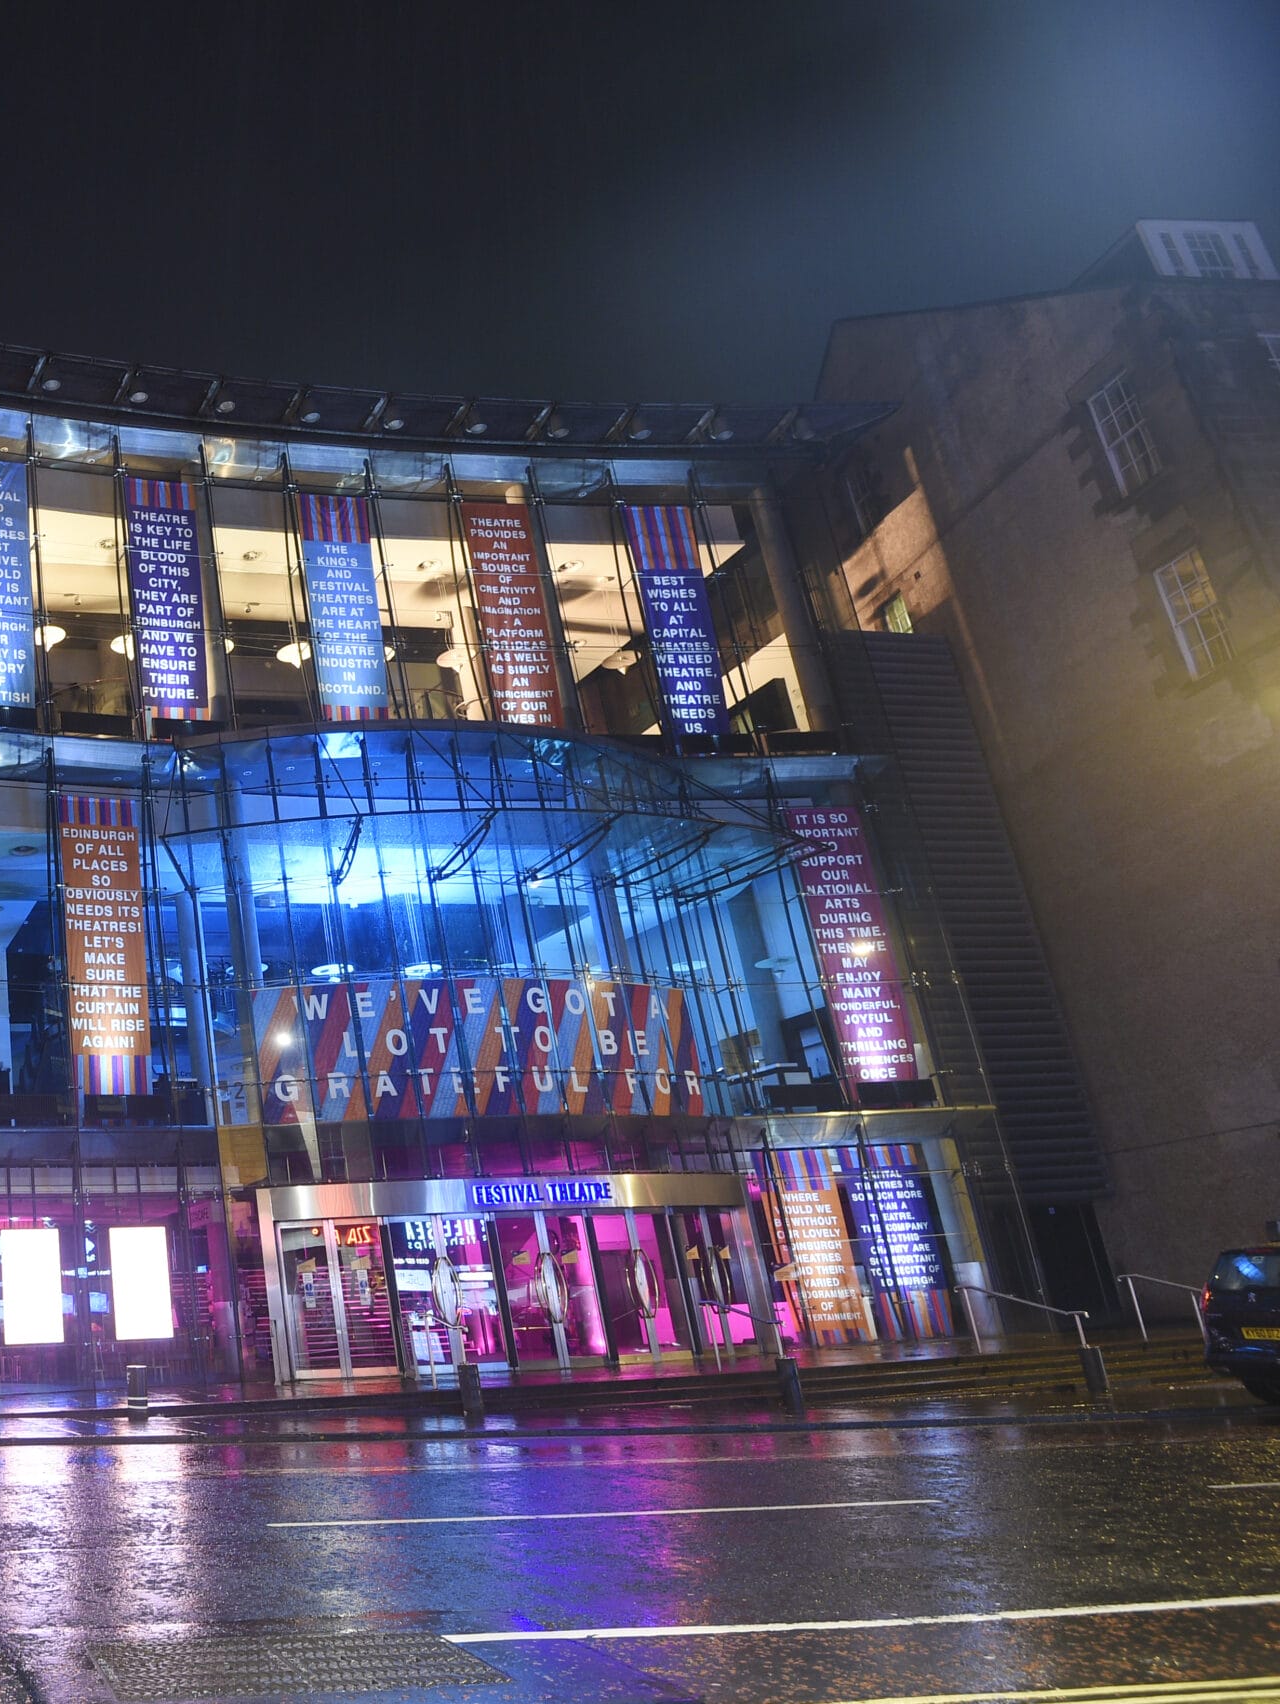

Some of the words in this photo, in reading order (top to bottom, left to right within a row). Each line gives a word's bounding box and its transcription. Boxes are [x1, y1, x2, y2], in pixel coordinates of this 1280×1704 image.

[133, 511, 188, 524] THEATRE
[471, 517, 521, 527] THEATRE
[470, 529, 526, 539] PROVIDES
[141, 550, 186, 563] BLOOD
[317, 557, 358, 566] KING'S
[474, 553, 530, 561] IMPORTANT
[481, 563, 526, 573] SOURCE
[327, 570, 352, 579] AND
[149, 578, 181, 591] CITY,
[654, 576, 685, 585] BEST
[312, 581, 369, 592] FESTIVAL
[480, 585, 536, 594] CREATIVITY
[134, 589, 167, 602] THEY
[310, 593, 373, 604] THEATRES
[647, 589, 696, 599] WISHES
[139, 603, 172, 616] PART
[322, 607, 346, 616] ARE
[338, 619, 378, 630] HEART
[486, 628, 543, 637] PLATFORM
[653, 628, 706, 638] CAPITAL
[141, 644, 174, 656] HAVE
[319, 645, 375, 655] THEATRE
[142, 658, 196, 671] ENSURE
[679, 655, 712, 664] NEED
[508, 665, 550, 674] SIMPLY
[150, 673, 189, 685] THEIR
[676, 681, 701, 691] AND
[142, 686, 199, 700] FUTURE.
[672, 709, 715, 718] NEEDS
[63, 827, 135, 841] EDINBURGH
[73, 859, 128, 872] PLACES
[801, 854, 863, 867] SUPPORT
[807, 883, 871, 895] NATIONAL
[66, 888, 138, 902] OBVIOUSLY
[66, 904, 113, 917] NEEDS
[819, 913, 871, 924] DURING
[66, 919, 141, 933] THEATRES!
[848, 926, 886, 938] TIME.
[84, 936, 124, 949] LET'S
[84, 952, 125, 965] MAKE
[75, 1002, 139, 1015] CURTAIN
[292, 987, 485, 1021] WE'VE
[526, 987, 617, 1017] GOT
[651, 994, 669, 1020] A
[844, 1013, 892, 1024] JOYFUL
[82, 1036, 134, 1048] AGAIN!
[344, 1027, 447, 1058] LOT
[496, 1026, 553, 1053] TO
[600, 1030, 649, 1056] BE
[274, 1065, 588, 1101] GRATEFUL
[625, 1069, 701, 1097] FOR
[472, 1184, 544, 1204] FESTIVAL
[546, 1182, 612, 1202] THEATRE
[782, 1193, 820, 1202] WHERE
[791, 1216, 837, 1226] WITHOUT
[803, 1229, 841, 1237] LOVELY
[886, 1223, 928, 1232] COMPANY
